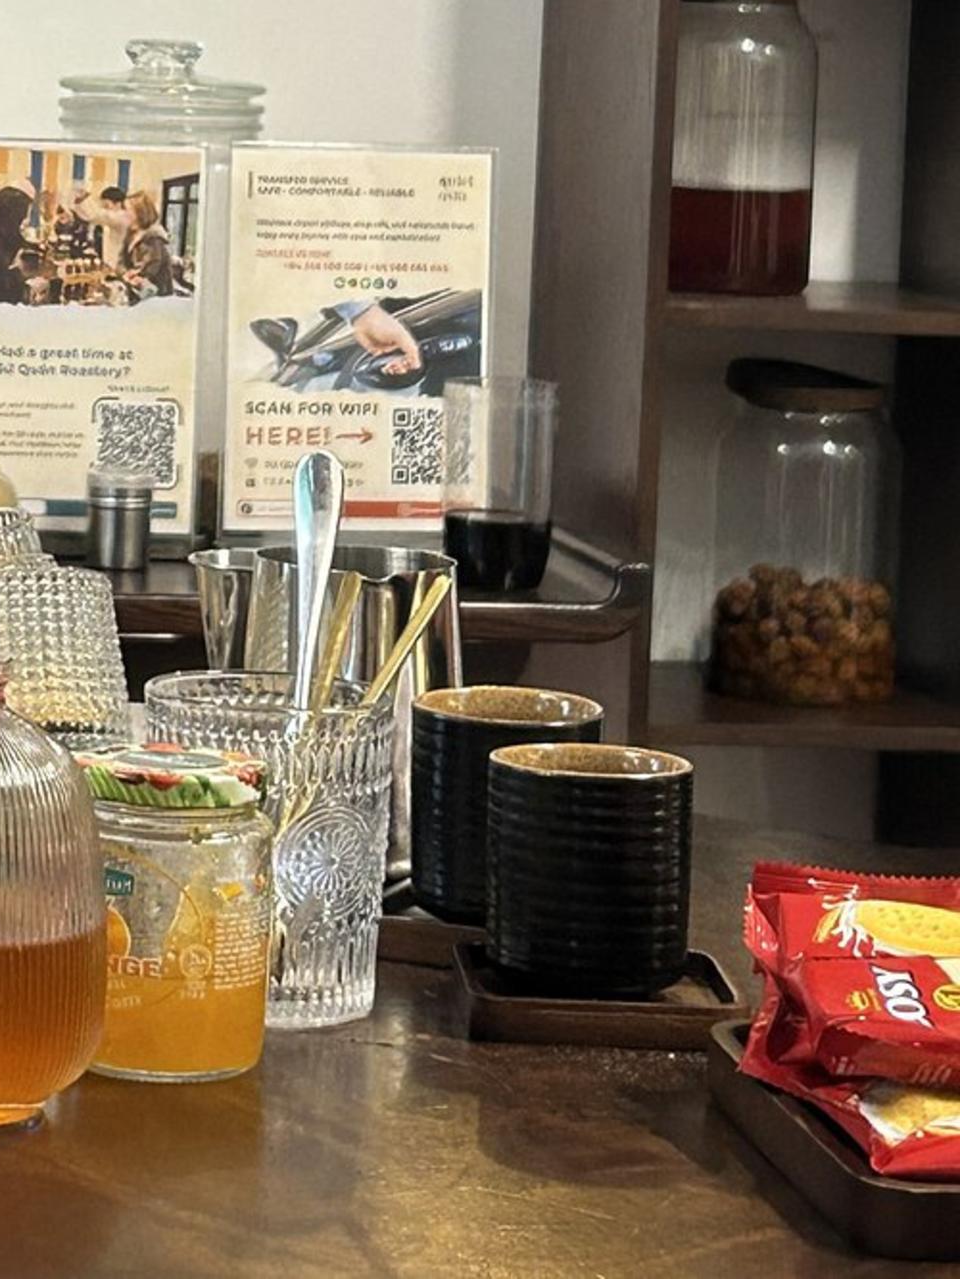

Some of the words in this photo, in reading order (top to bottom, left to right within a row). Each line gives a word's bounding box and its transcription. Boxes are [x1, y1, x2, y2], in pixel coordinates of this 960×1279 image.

[40, 348, 79, 361] great
[81, 348, 114, 361] time
[245, 401, 291, 415] SCAN
[298, 402, 332, 415] FOR
[246, 426, 331, 446] HERE!
[107, 955, 162, 979] NGE
